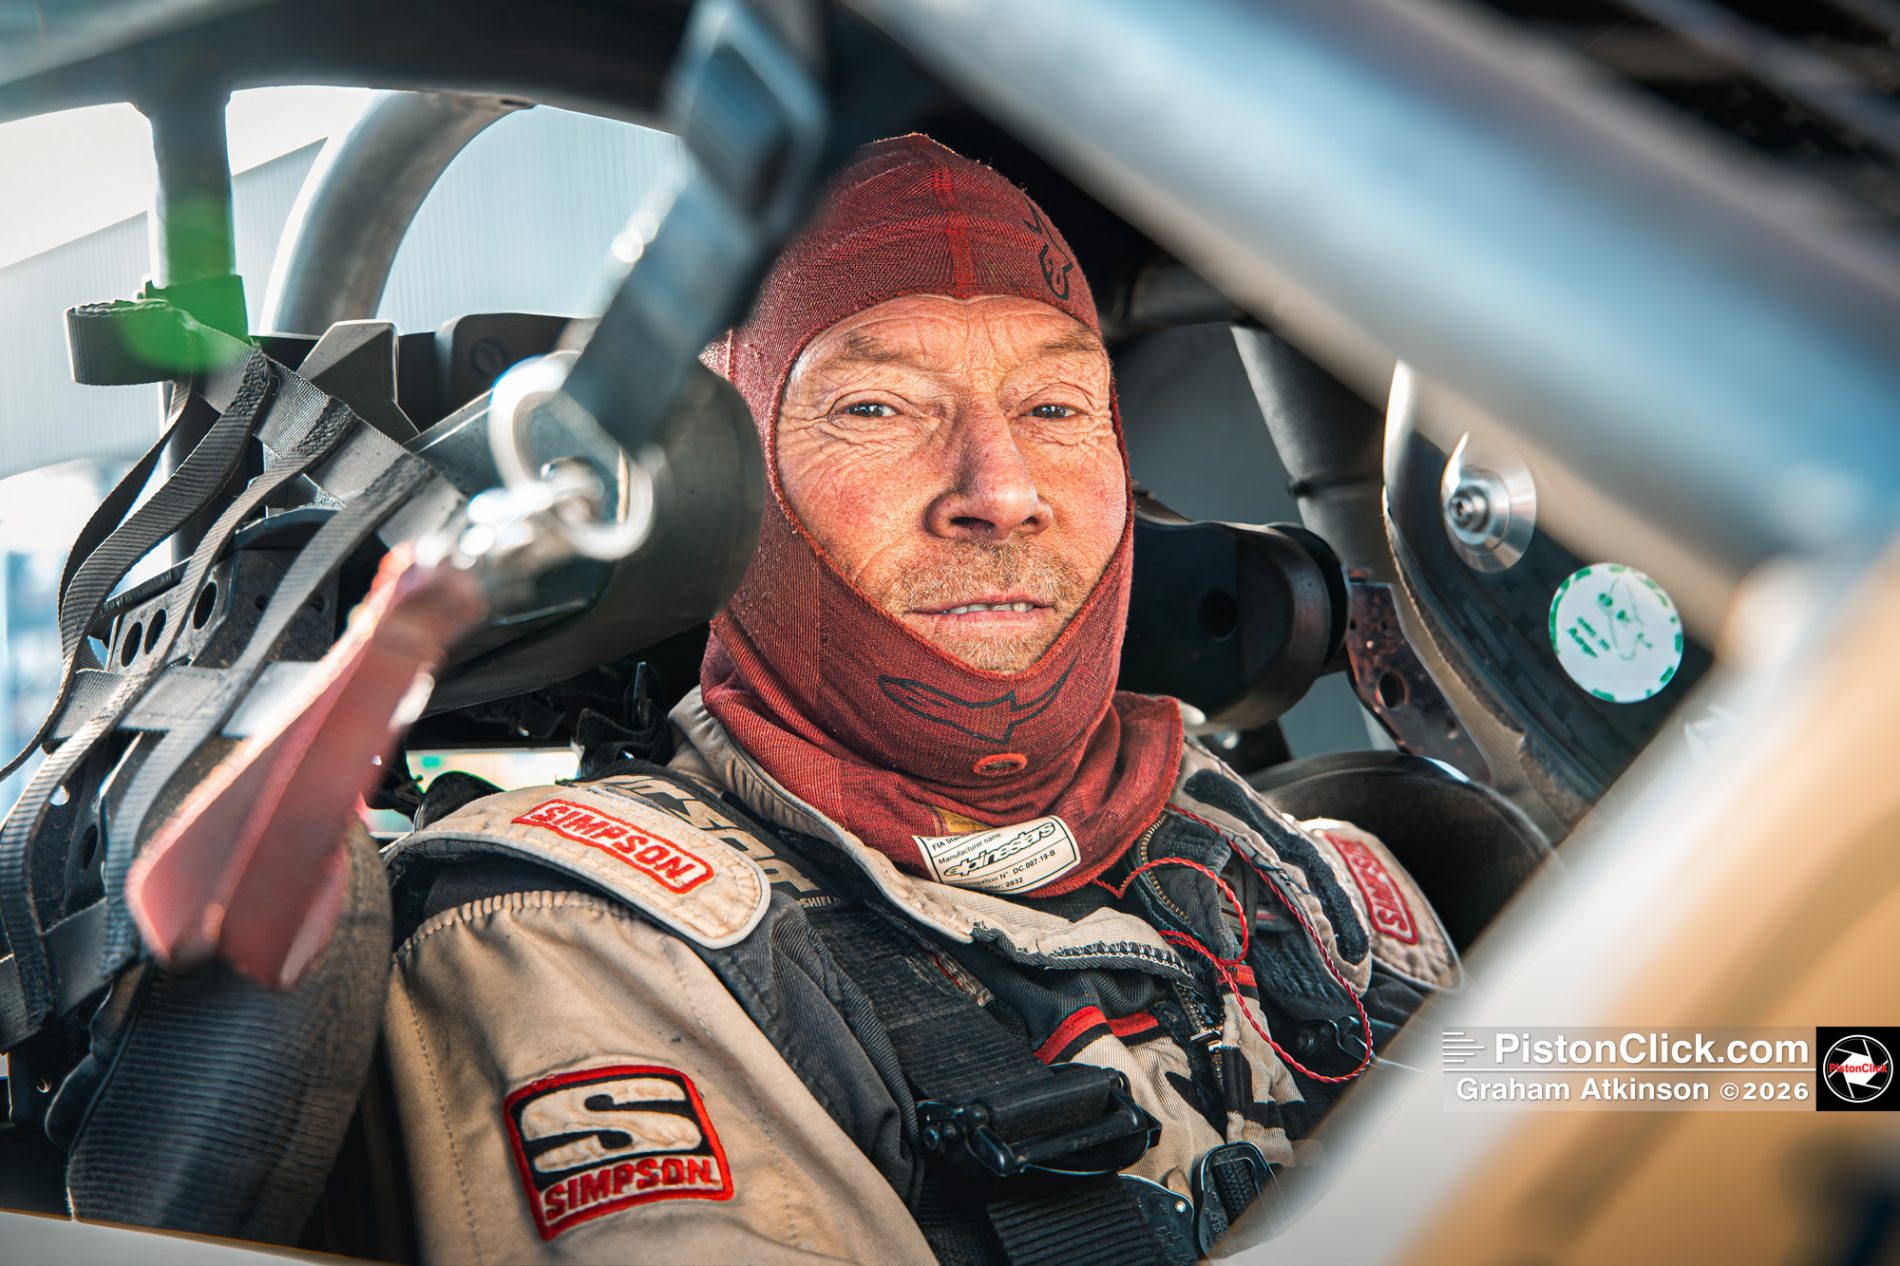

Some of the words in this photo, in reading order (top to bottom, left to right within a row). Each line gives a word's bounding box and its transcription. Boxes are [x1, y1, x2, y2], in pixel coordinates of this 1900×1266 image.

[531, 805, 697, 879] SIMPSON
[932, 841, 946, 850] FIA
[938, 842, 983, 864] Manufacturer
[1005, 876, 1023, 888] 2032
[544, 1157, 721, 1222] SIMPSON
